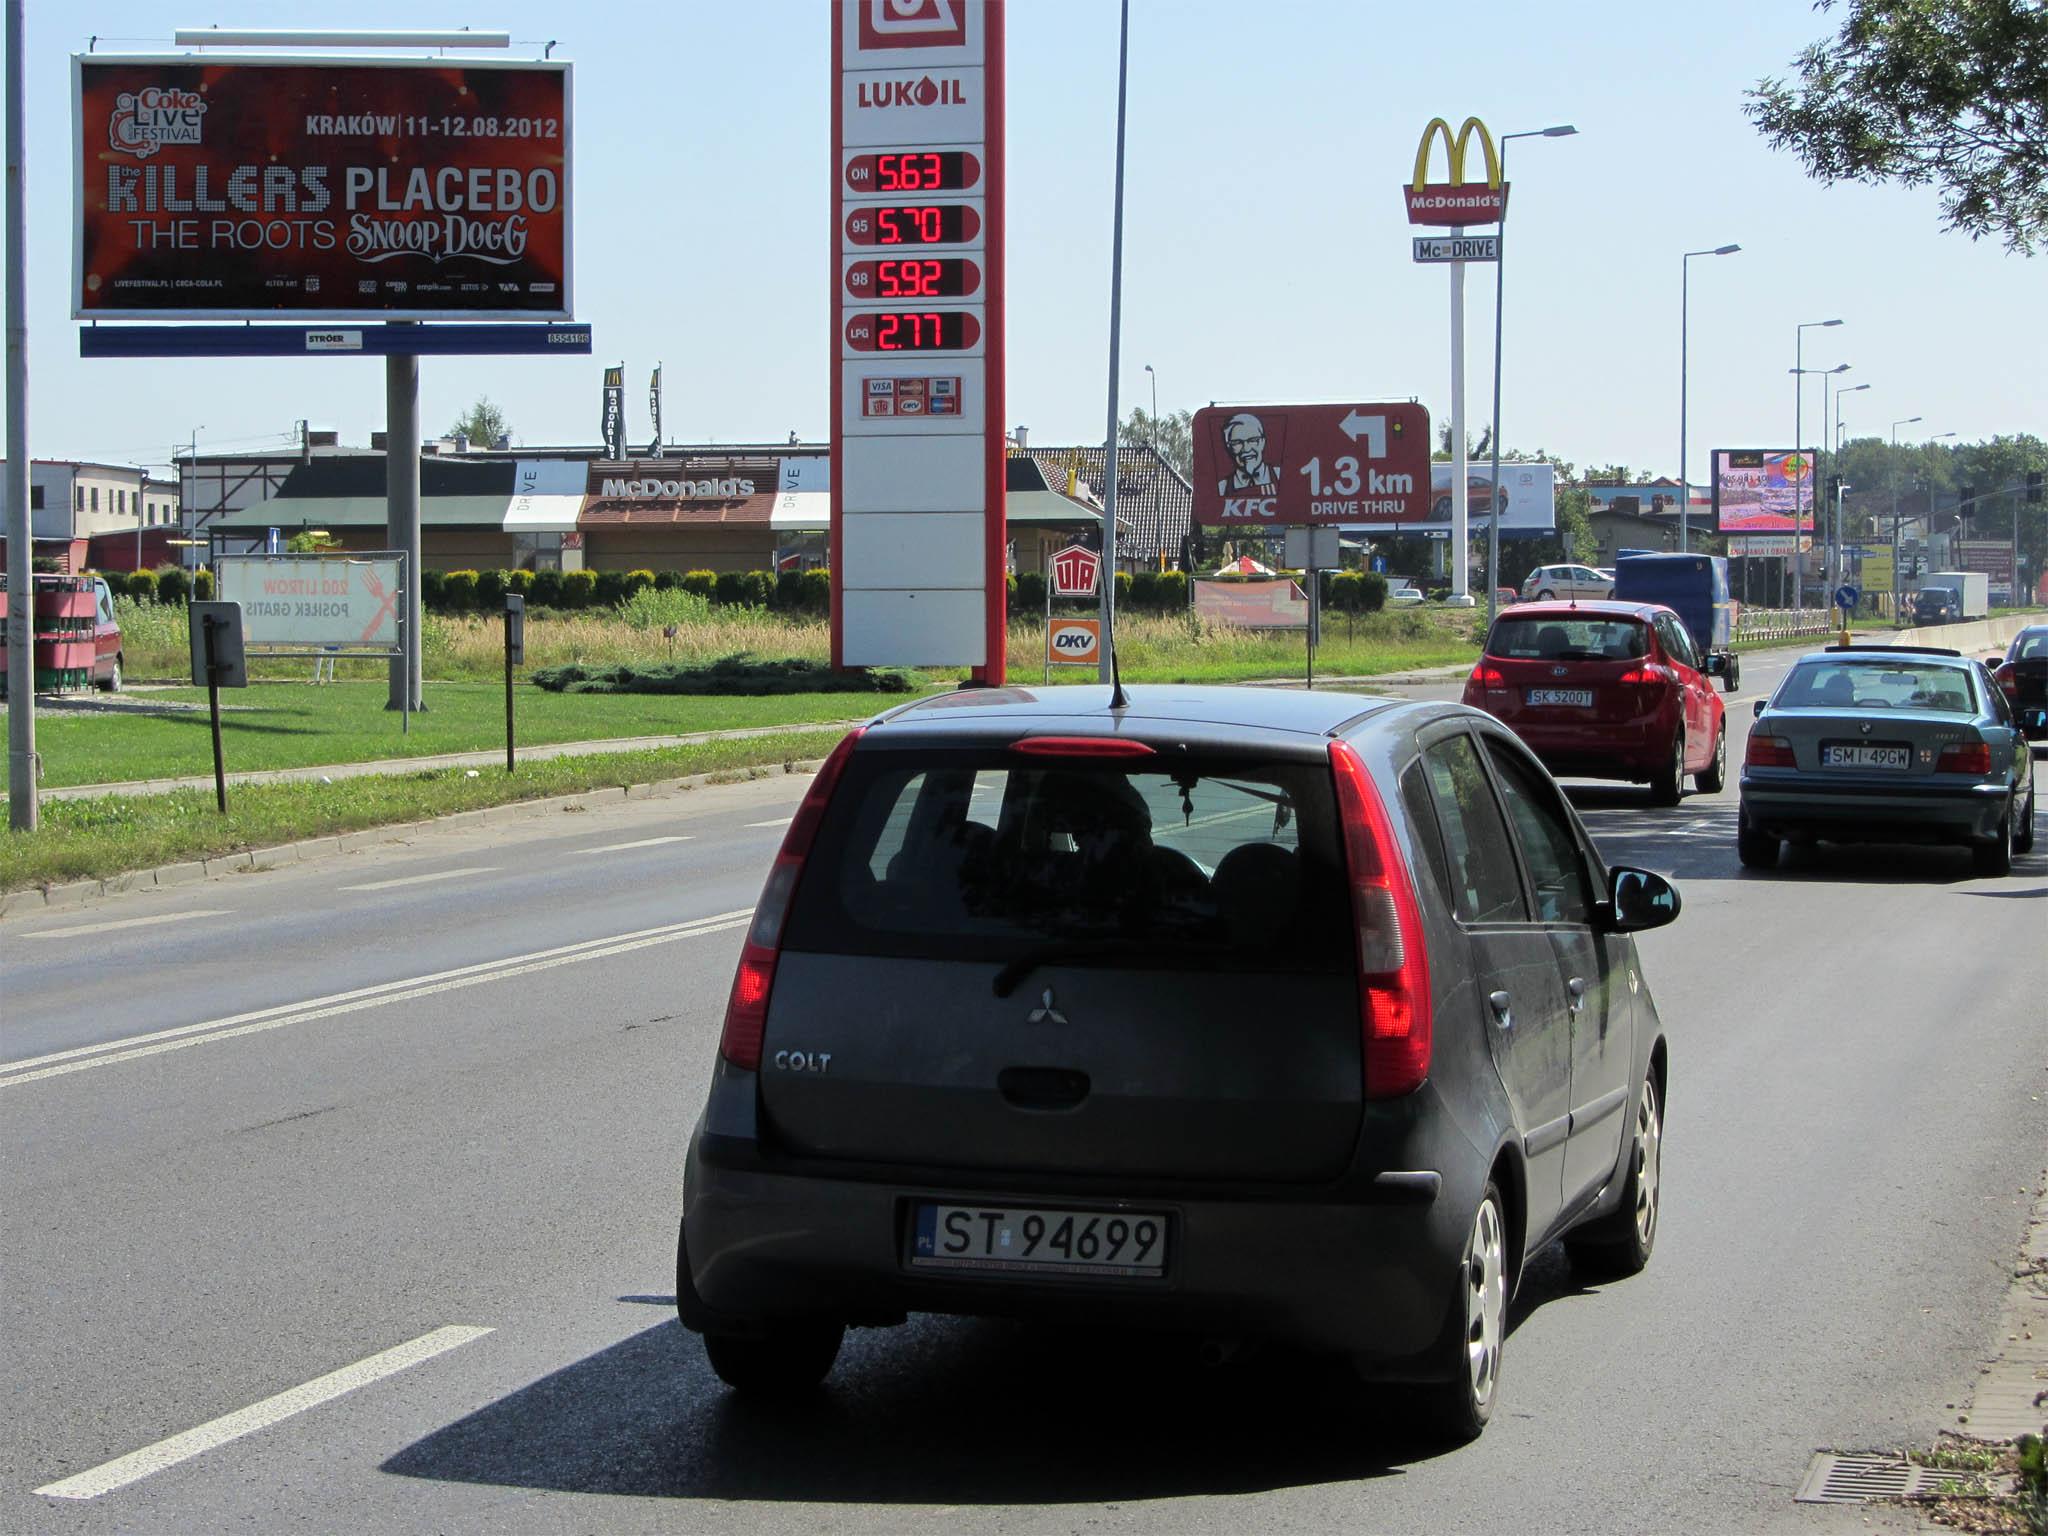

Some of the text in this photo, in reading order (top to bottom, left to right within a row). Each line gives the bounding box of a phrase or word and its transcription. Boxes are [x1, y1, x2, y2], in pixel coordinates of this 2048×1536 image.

[141, 89, 198, 109] Coke
[134, 98, 199, 126] Live
[133, 128, 199, 140] FESTIVAL
[306, 110, 558, 140] KRAKÓW 11-12.08.2012
[851, 154, 942, 191] ON 5.63
[108, 165, 557, 213] KILLERS PLACEBO
[1411, 195, 1500, 209] McDonald's
[128, 219, 199, 250] THE
[211, 219, 336, 250] ROOTS
[852, 208, 942, 244] 95 5.70
[1420, 240, 1493, 258] Mc DRIVE
[852, 260, 942, 297] 98 5.92
[850, 313, 942, 350] LPG 2.77
[872, 382, 892, 391] VISA
[1299, 455, 1413, 497] 1.3 km
[602, 477, 755, 498] McDonald's
[1221, 498, 1277, 517] KFC
[1311, 499, 1405, 515] DRIVE THRU
[1054, 547, 1099, 591] UTA
[1055, 634, 1093, 649] DKV
[1533, 691, 1592, 705] SK 5200T
[1831, 749, 1909, 766] SMI 49GW
[775, 1050, 832, 1073] COLT
[917, 1236, 933, 1249] PL
[943, 1210, 1158, 1262] ST 94699
